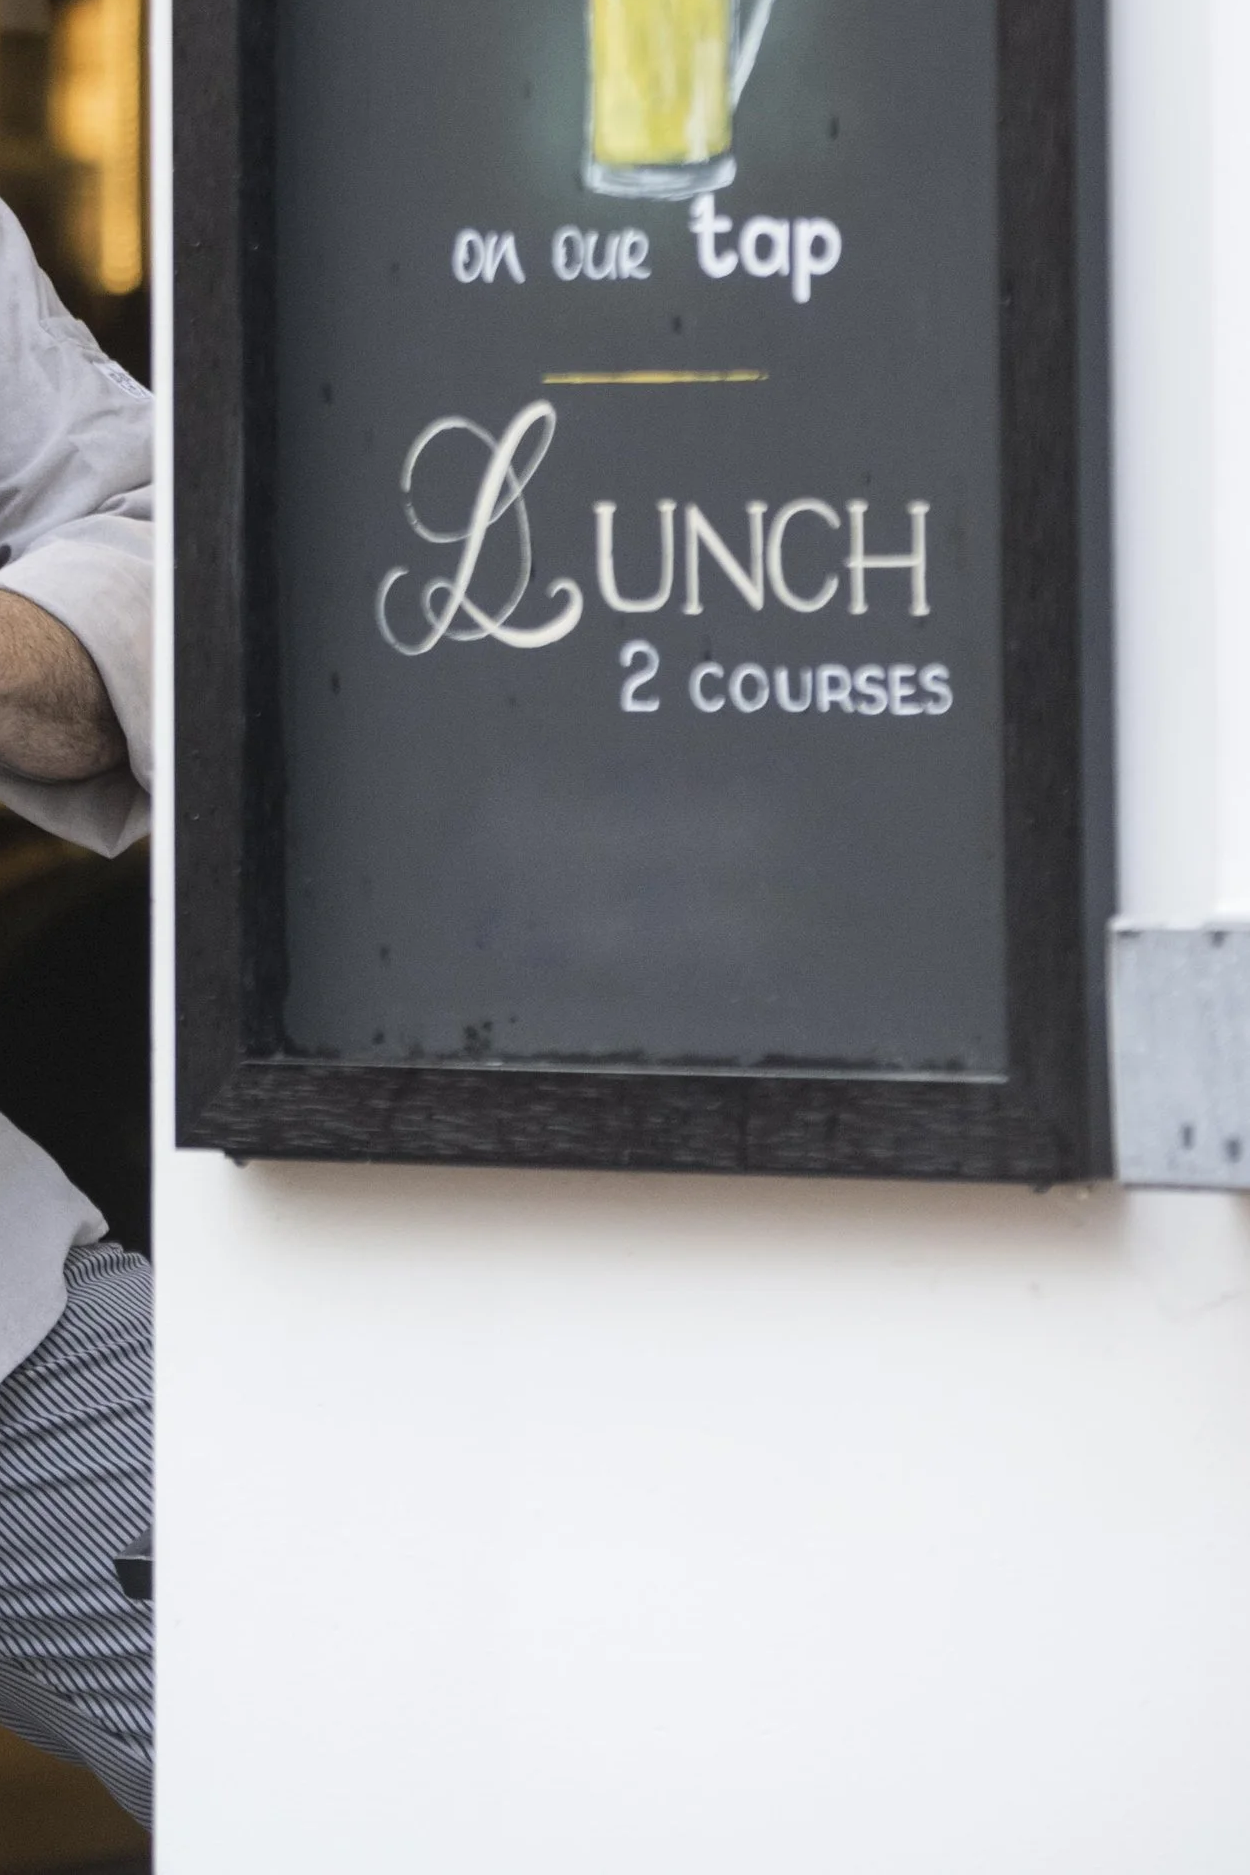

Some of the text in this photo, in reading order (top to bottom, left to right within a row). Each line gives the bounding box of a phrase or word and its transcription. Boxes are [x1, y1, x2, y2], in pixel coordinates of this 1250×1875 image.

[688, 193, 842, 304] tap
[374, 400, 931, 656] LUNCH
[618, 640, 954, 716] 2 COURSES
